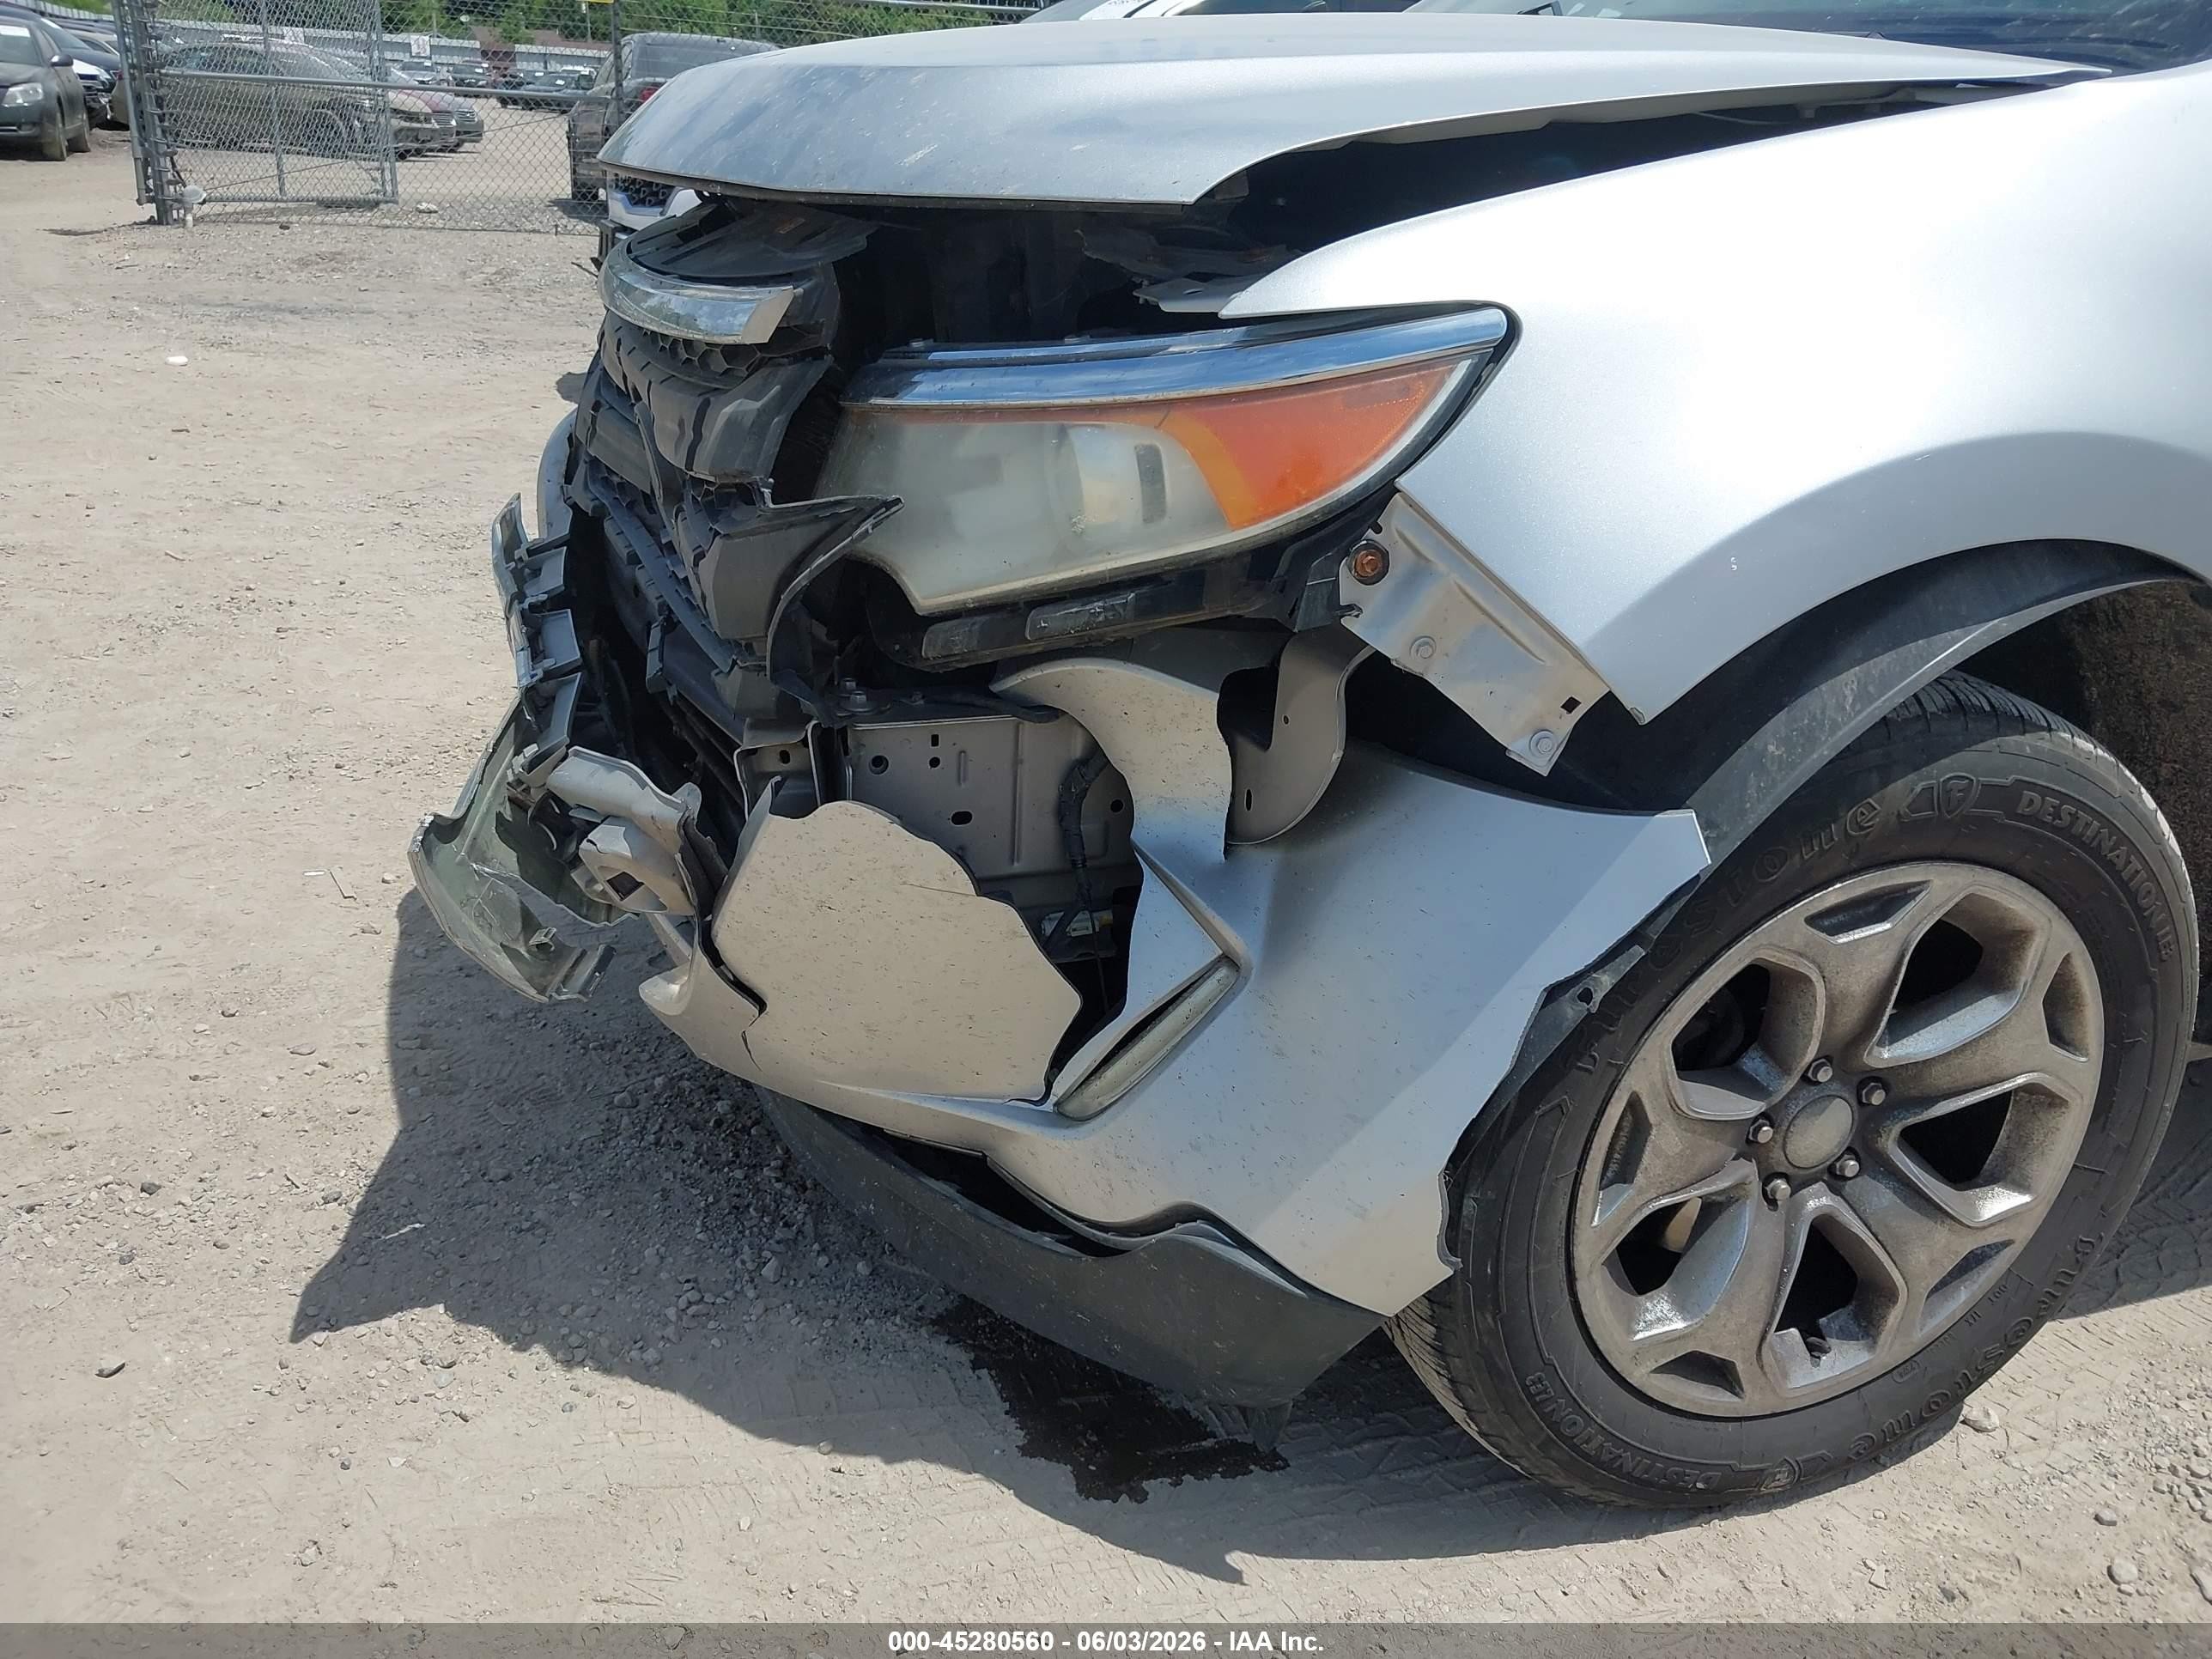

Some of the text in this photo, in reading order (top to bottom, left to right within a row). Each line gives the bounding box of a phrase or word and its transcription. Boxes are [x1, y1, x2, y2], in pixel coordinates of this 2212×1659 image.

[2016, 789, 2168, 931] DESTINATION
[1848, 1231, 2105, 1460] Firestone
[1545, 1397, 1723, 1491] DESTINATION
